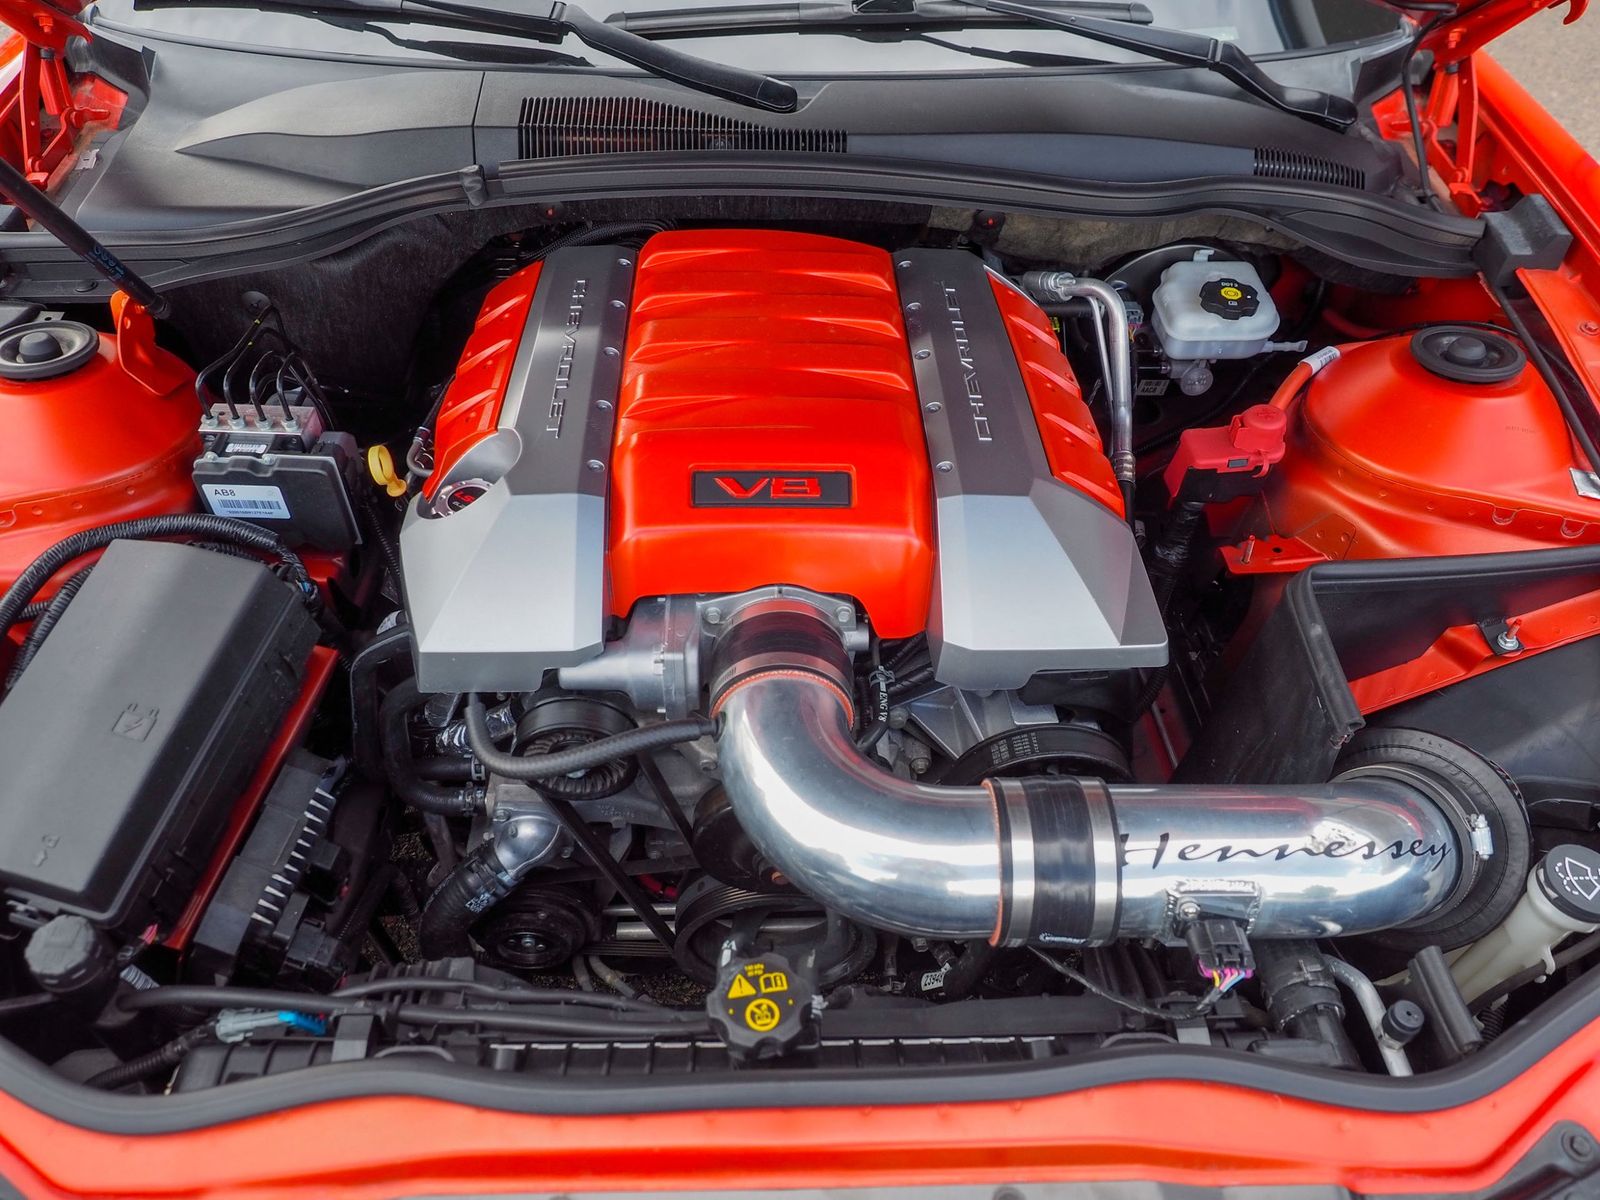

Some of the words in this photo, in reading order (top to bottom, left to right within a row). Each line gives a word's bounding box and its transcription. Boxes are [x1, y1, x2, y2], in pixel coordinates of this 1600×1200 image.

[546, 279, 586, 439] CHEVROLET
[935, 280, 993, 441] CHEVROLET
[214, 488, 236, 497] AB8
[713, 476, 822, 499] V8
[879, 691, 888, 710] ENG
[1119, 832, 1452, 870] Hennessey
